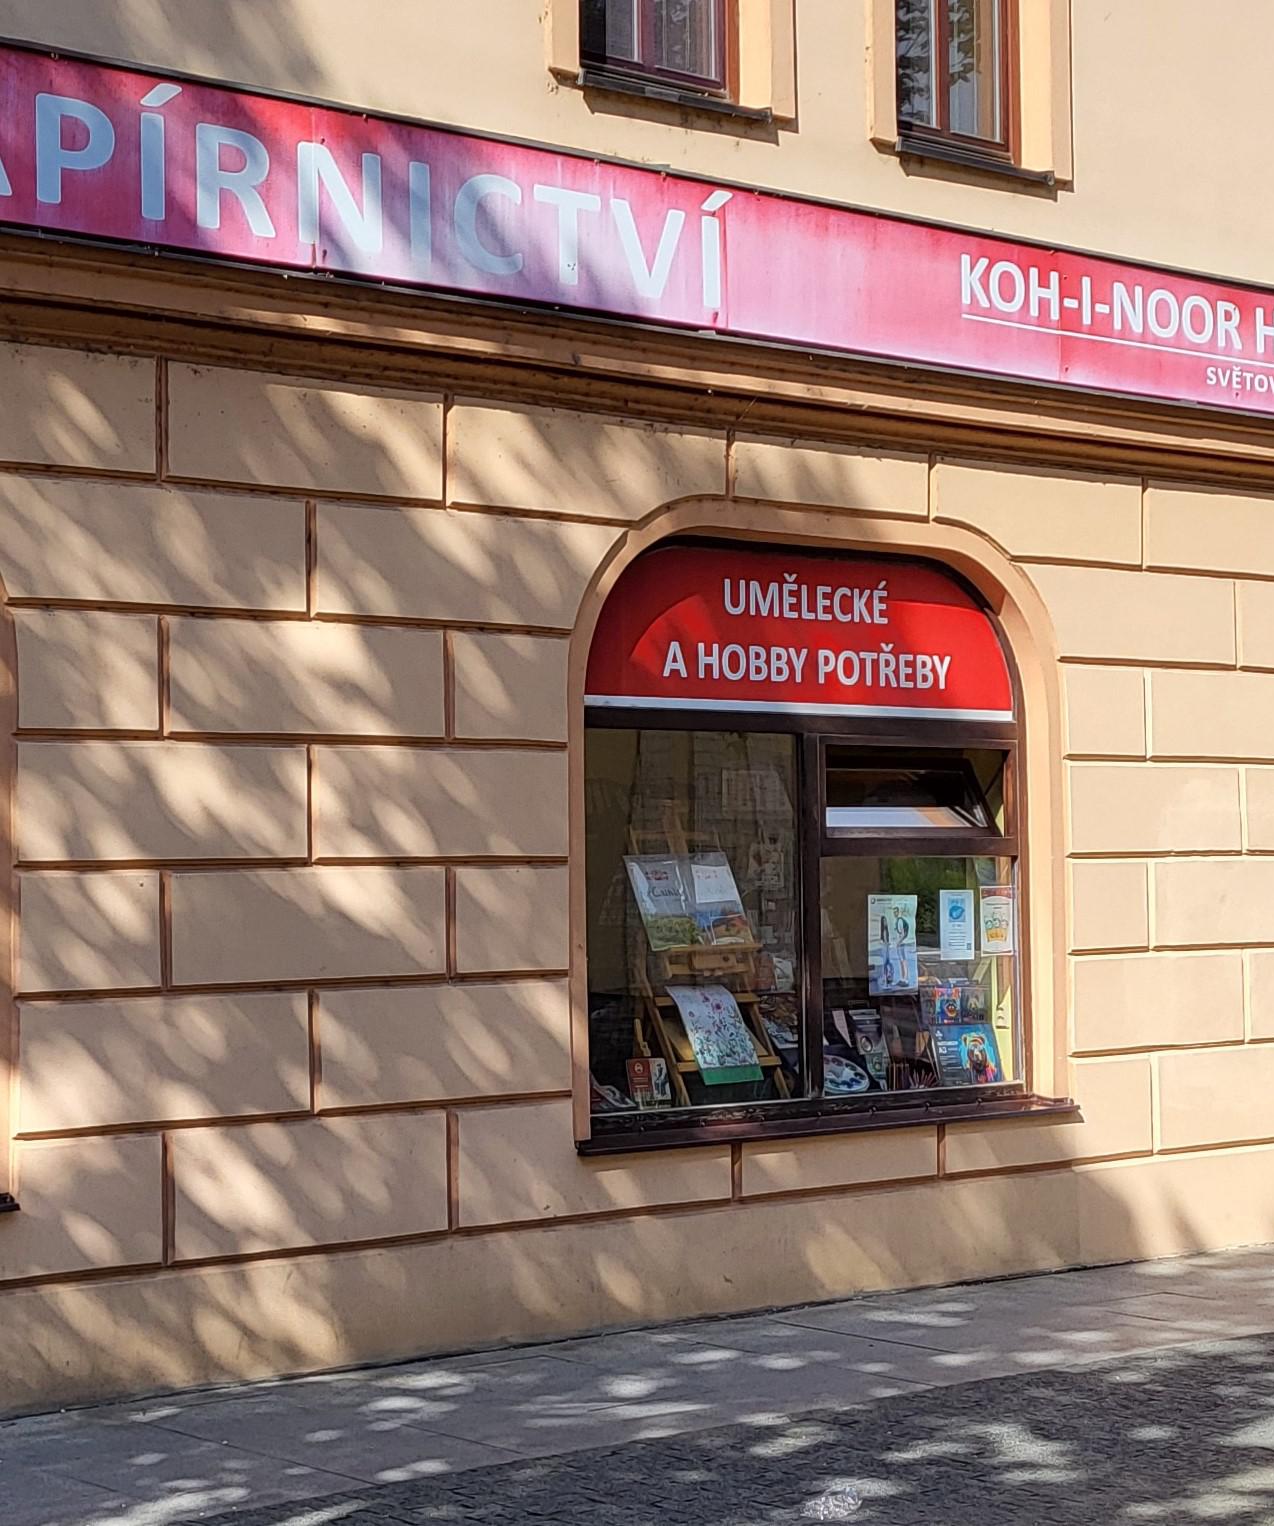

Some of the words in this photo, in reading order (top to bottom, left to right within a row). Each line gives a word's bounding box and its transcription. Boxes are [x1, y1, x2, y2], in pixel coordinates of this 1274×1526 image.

[0, 83, 733, 309] PÍRNICTVÍ
[960, 253, 1243, 351] KOH-I-NOOR
[723, 573, 889, 625] UMĚLECKÉ
[663, 640, 688, 678] A
[698, 641, 808, 683] HOBBY
[818, 643, 952, 690] POTŘEBY
